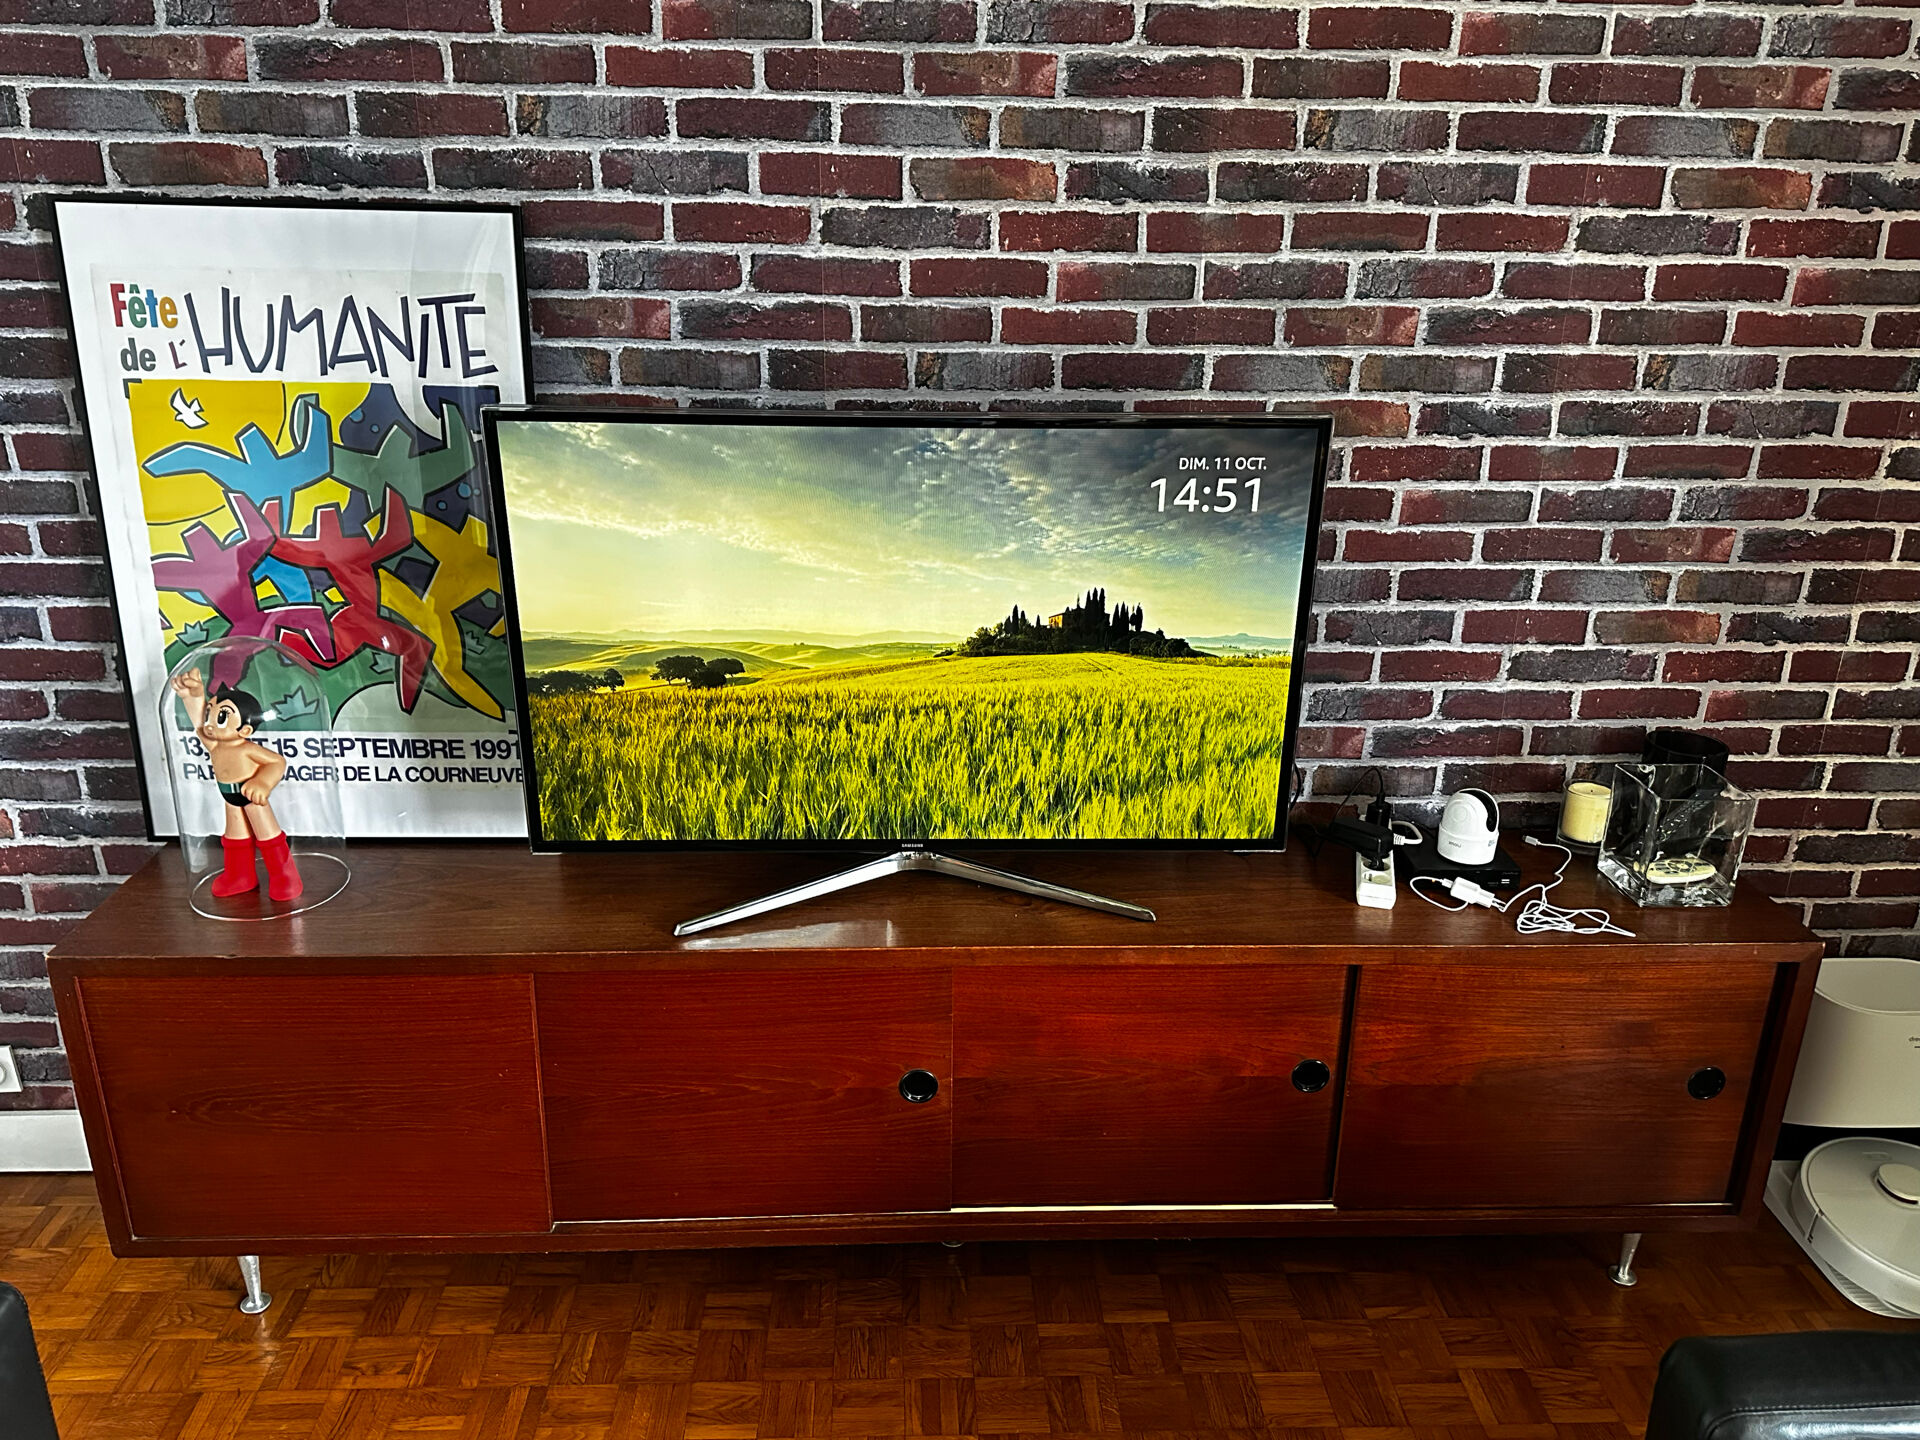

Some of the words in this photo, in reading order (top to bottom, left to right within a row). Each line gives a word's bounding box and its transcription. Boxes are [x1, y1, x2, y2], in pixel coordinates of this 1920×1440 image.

[110, 283, 178, 328] Fête
[120, 337, 156, 371] de
[1178, 457, 1209, 470] DIM.
[1214, 457, 1230, 470] 11
[1234, 457, 1267, 470] OCT.
[1150, 477, 1261, 513] 14:51
[272, 738, 298, 758] 15
[303, 737, 466, 760] SEPTEMBRE
[470, 739, 521, 760] 1991
[343, 766, 372, 782] DE
[375, 766, 402, 782] LA
